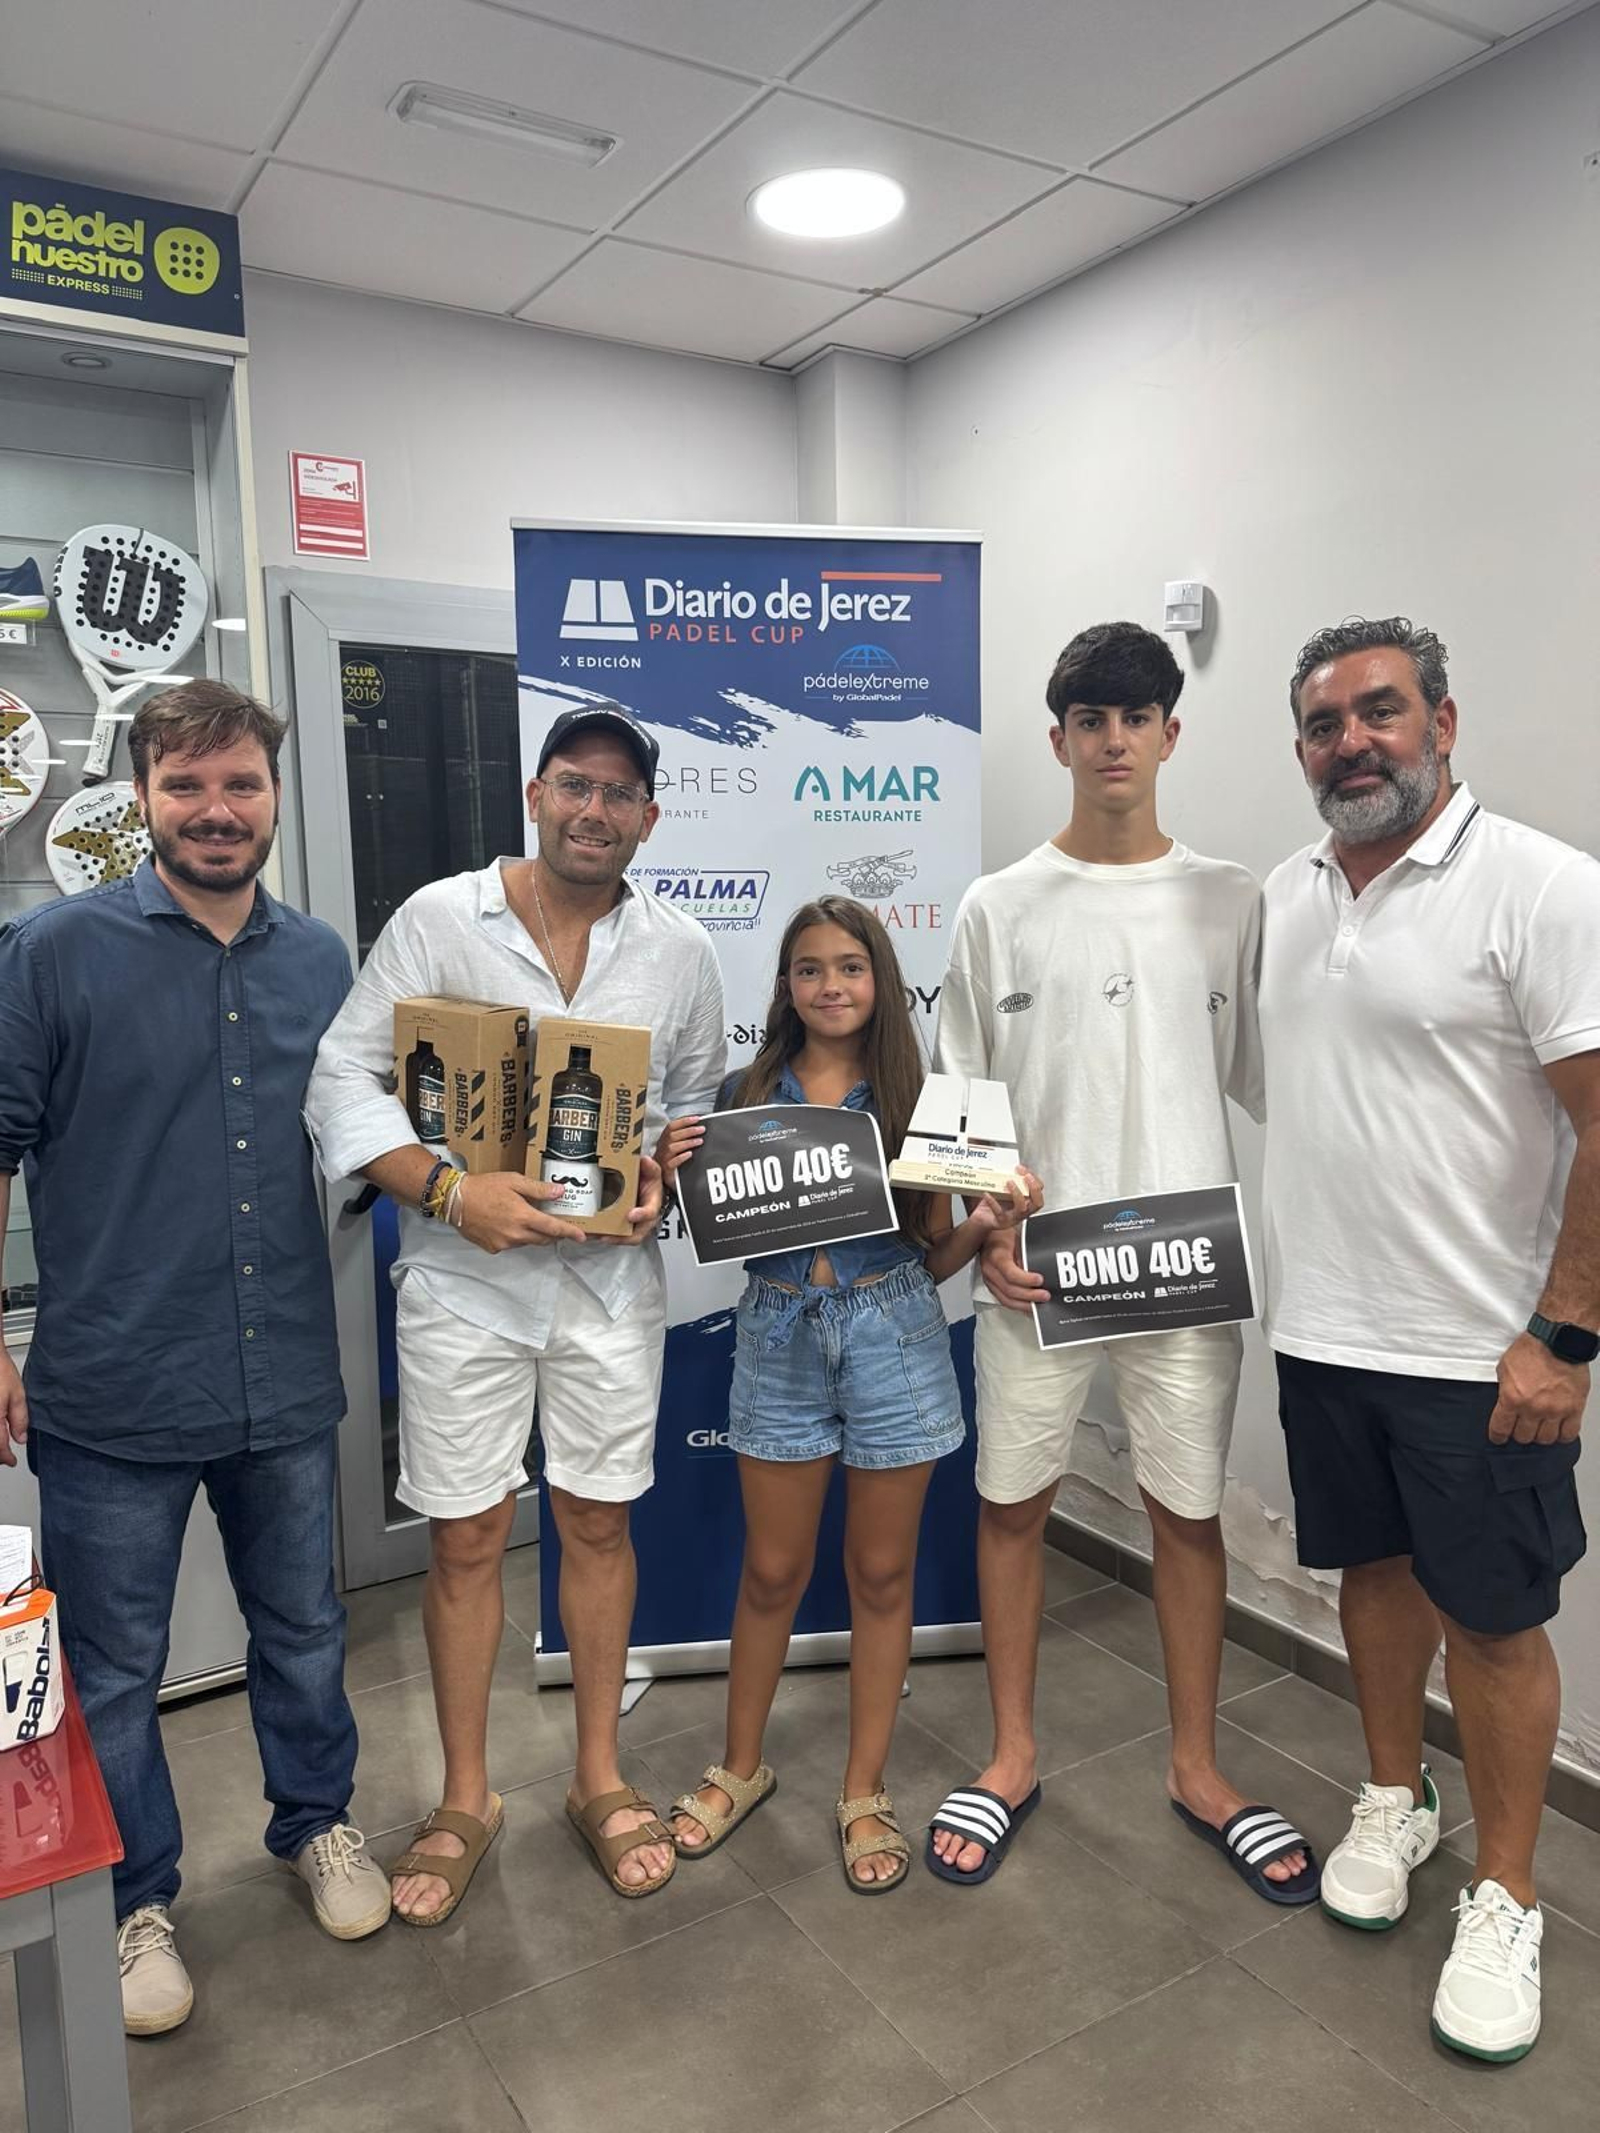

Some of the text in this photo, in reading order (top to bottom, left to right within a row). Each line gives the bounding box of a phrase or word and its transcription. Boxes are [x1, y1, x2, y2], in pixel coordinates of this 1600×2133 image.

[11, 239, 144, 283] nuestro
[47, 274, 110, 294] EXPRESS
[645, 578, 911, 632] Diario de Jerez
[650, 623, 804, 643] PADEL CUP
[560, 655, 642, 669] X EDICIÓN
[345, 666, 377, 678] CLUB
[345, 685, 381, 701] 2016
[832, 693, 843, 703] by
[843, 765, 941, 801] MAR
[662, 809, 710, 820] RANTE
[813, 809, 923, 823] RESTAURANTE
[630, 868, 642, 877] DE
[644, 866, 700, 878] FORMACIÓN
[654, 879, 758, 900] PALMA
[674, 903, 753, 914] CUELAS
[563, 1129, 582, 1142] GIN
[928, 1143, 953, 1155] Diario
[954, 1146, 966, 1155] de
[706, 1143, 853, 1205] BONO 40€
[715, 1200, 792, 1223] CAMPEÓN
[1056, 1236, 1216, 1289] BONO 40€
[1063, 1290, 1146, 1303] CAMPEÓN
[16, 1617, 50, 1740] Babolat
